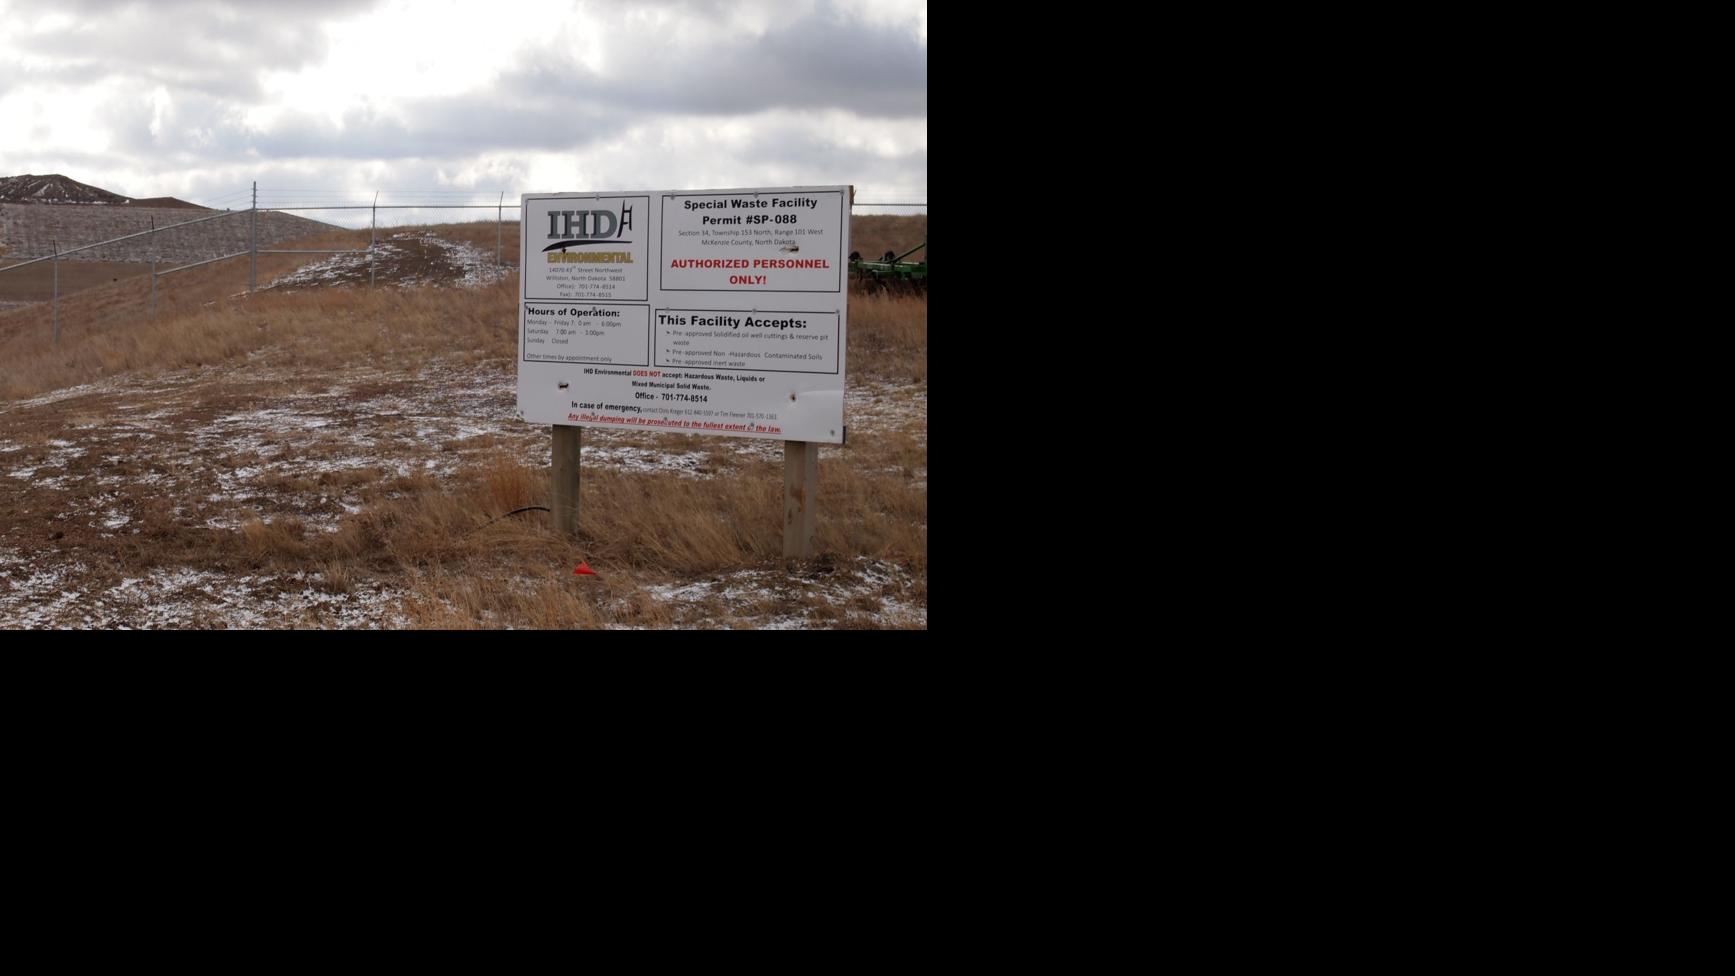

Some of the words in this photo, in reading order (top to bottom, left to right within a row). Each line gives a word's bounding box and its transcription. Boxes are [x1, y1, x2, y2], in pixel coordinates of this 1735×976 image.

[684, 200, 727, 211] Special
[731, 199, 768, 208] Waste
[772, 197, 818, 209] Facility
[547, 210, 618, 240] IHD
[702, 215, 742, 225] Permit
[746, 215, 798, 225] #SP-088
[712, 229, 740, 237] Township
[775, 229, 794, 237] Range
[731, 240, 754, 248] County,
[547, 251, 634, 264] ENVIRONMENTAL
[671, 259, 749, 269] AUTHORIZED
[753, 259, 830, 269] PERSONNEL
[729, 275, 767, 285] ONLY!
[528, 308, 555, 316] Hours
[558, 308, 567, 316] of
[570, 308, 620, 318] Operation:
[658, 315, 686, 325] This
[691, 316, 740, 329] Facility
[744, 317, 807, 330] Accepts:
[764, 352, 807, 360] Contaminated
[662, 371, 683, 379] accept:
[661, 394, 708, 402] 701-774-8514
[605, 404, 642, 413] emergency,
[581, 413, 598, 421] illegal
